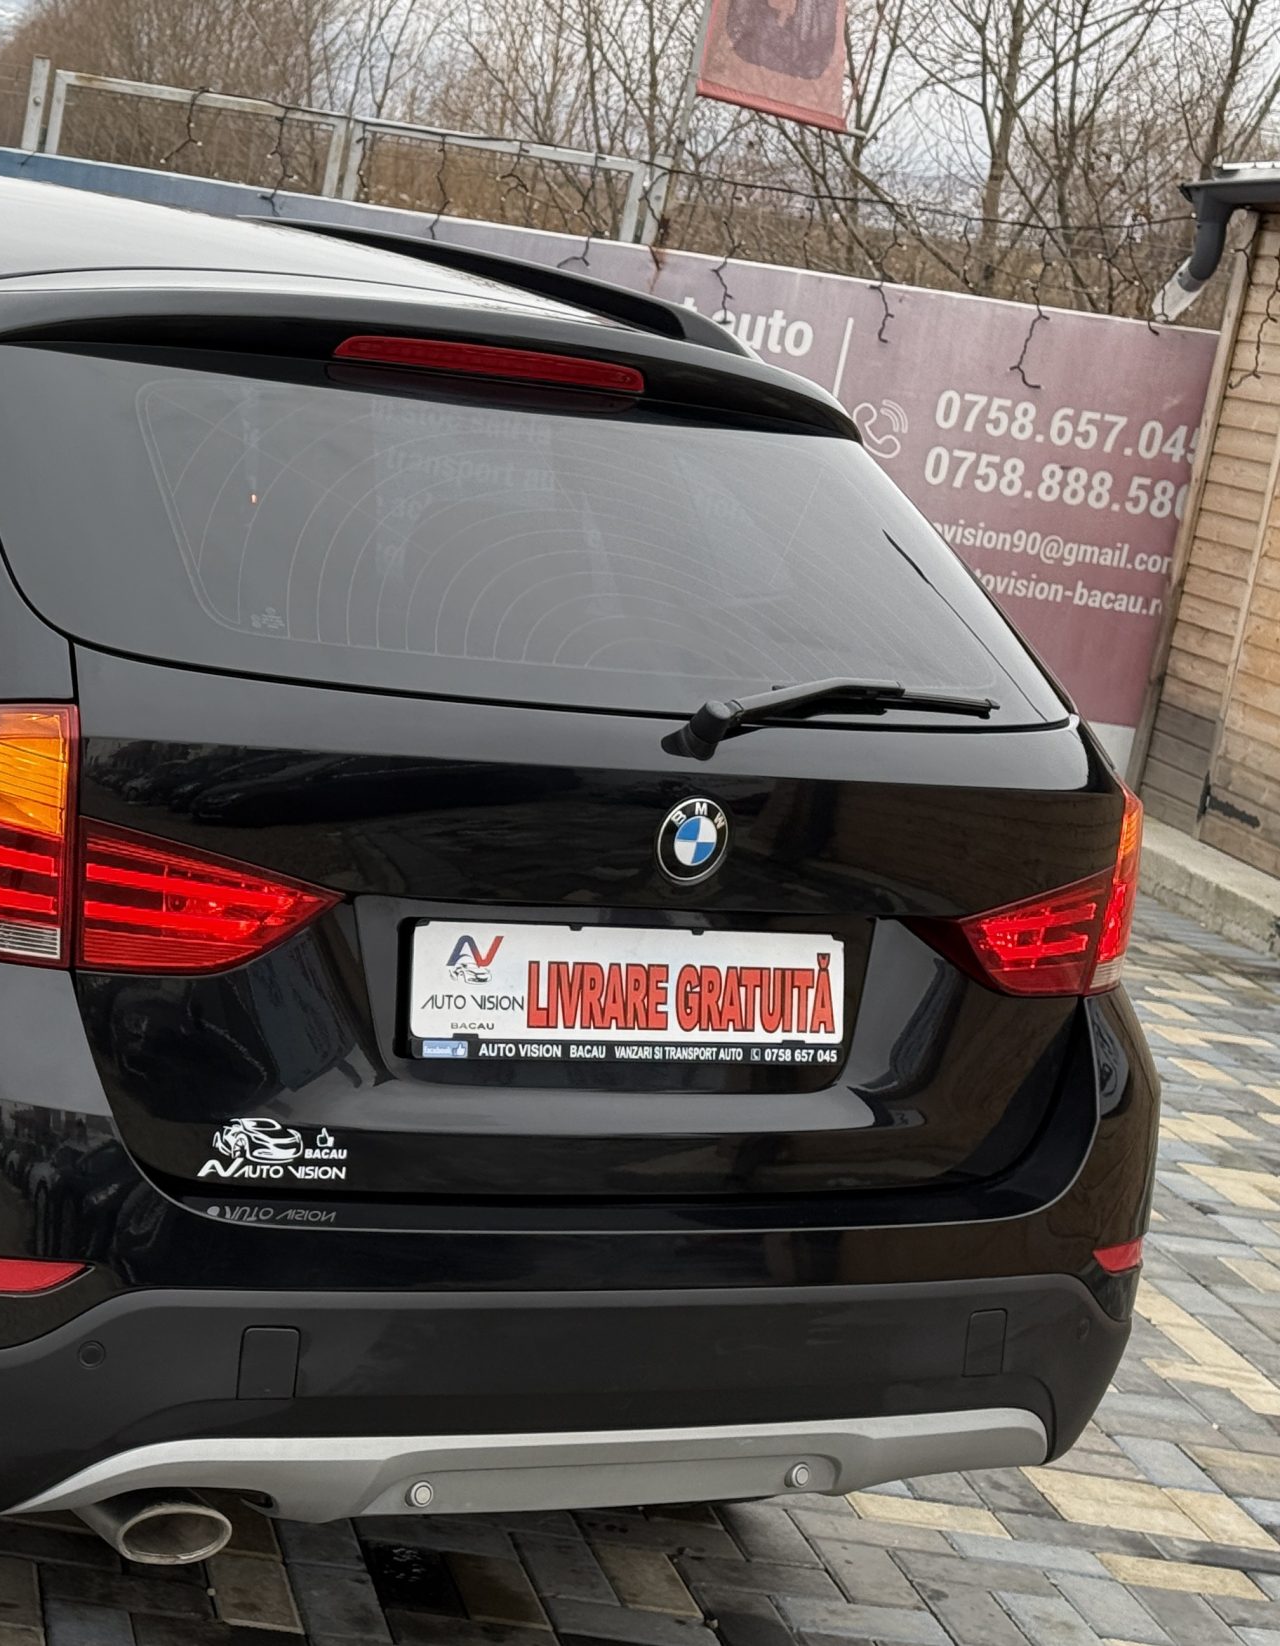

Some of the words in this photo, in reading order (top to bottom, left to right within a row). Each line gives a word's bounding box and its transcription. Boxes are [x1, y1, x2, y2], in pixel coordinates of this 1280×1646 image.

[671, 802, 725, 829] BMW
[527, 961, 669, 1030] LIVRARE
[675, 953, 835, 1034] GRATUITĂ
[421, 995, 467, 1010] AUTO
[470, 995, 524, 1011] VISION
[451, 1022, 495, 1031] BACAU
[478, 1043, 516, 1057] AUTO
[518, 1044, 562, 1058] VISION
[570, 1045, 606, 1059] BACAU
[615, 1046, 653, 1060] VANZARI
[654, 1047, 663, 1060] SI
[665, 1047, 718, 1061] TRANSPORT
[719, 1048, 743, 1061] AUTO
[764, 1048, 792, 1062] 0758
[794, 1049, 815, 1062] 657
[817, 1050, 838, 1063] 045
[304, 1149, 348, 1160] BACAU
[233, 1165, 284, 1179] AUTO
[287, 1165, 347, 1180] VISION
